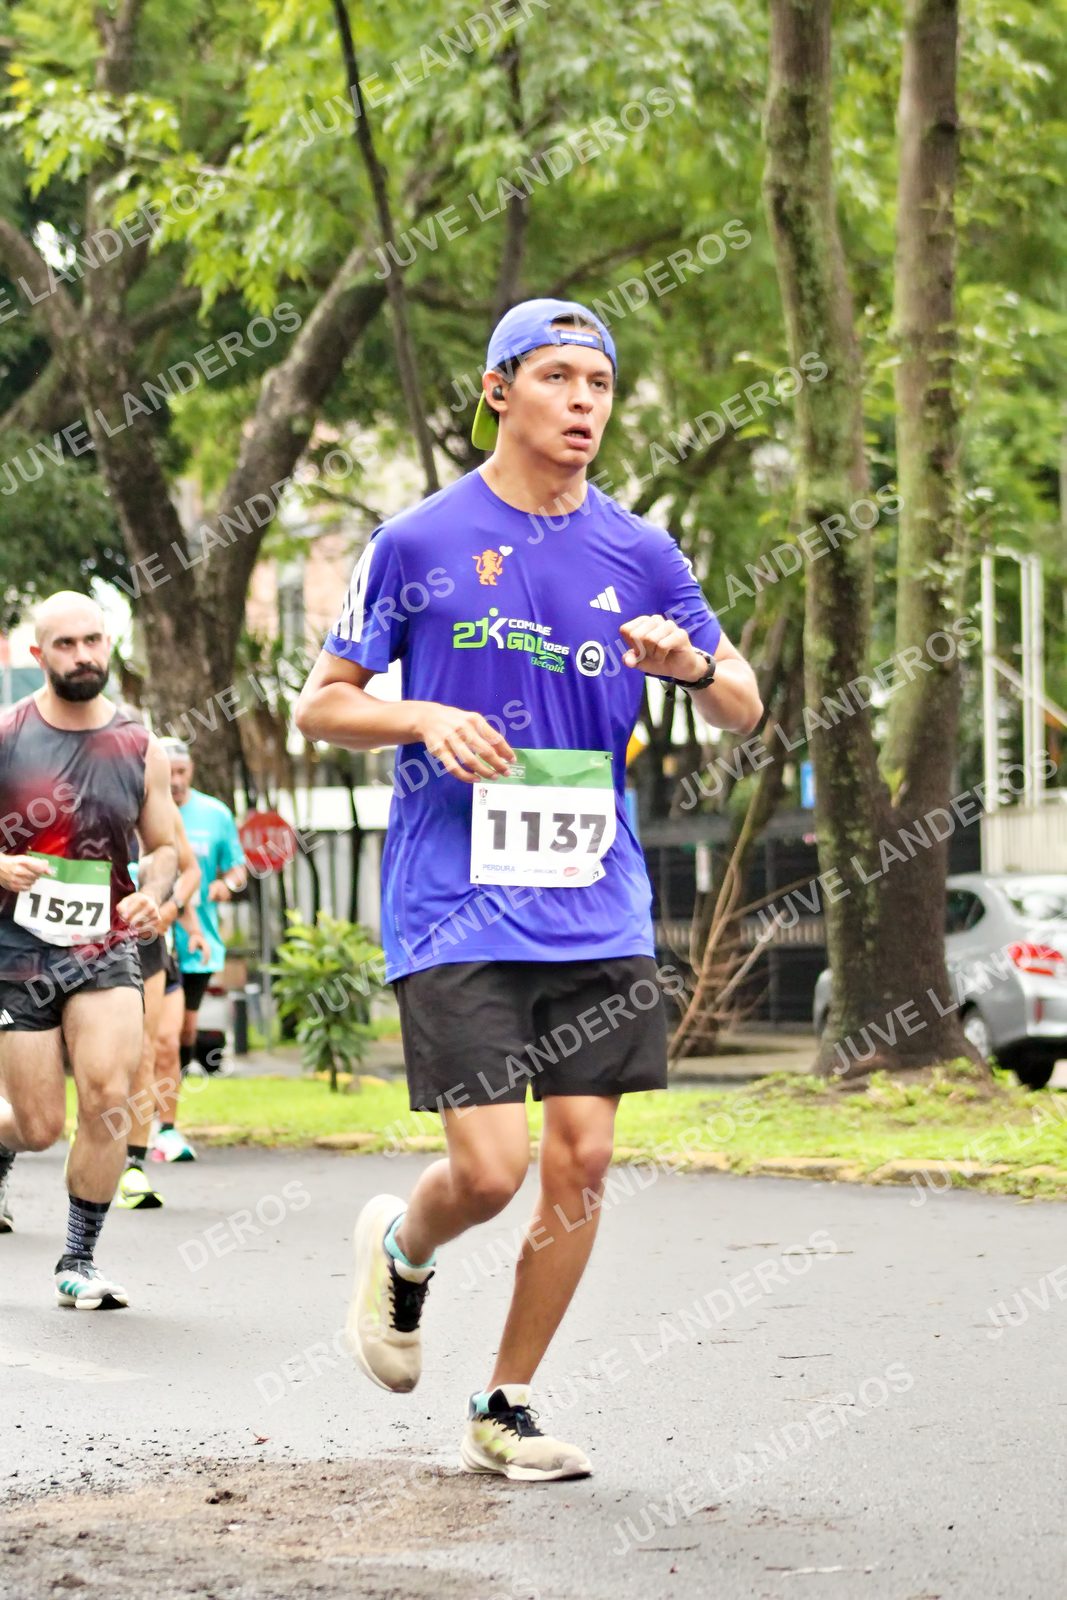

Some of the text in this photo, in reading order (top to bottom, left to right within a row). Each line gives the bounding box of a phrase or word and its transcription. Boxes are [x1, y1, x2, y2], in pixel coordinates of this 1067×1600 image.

[506, 631, 547, 655] GDL
[487, 809, 607, 854] 1137
[29, 892, 104, 927] 1527
